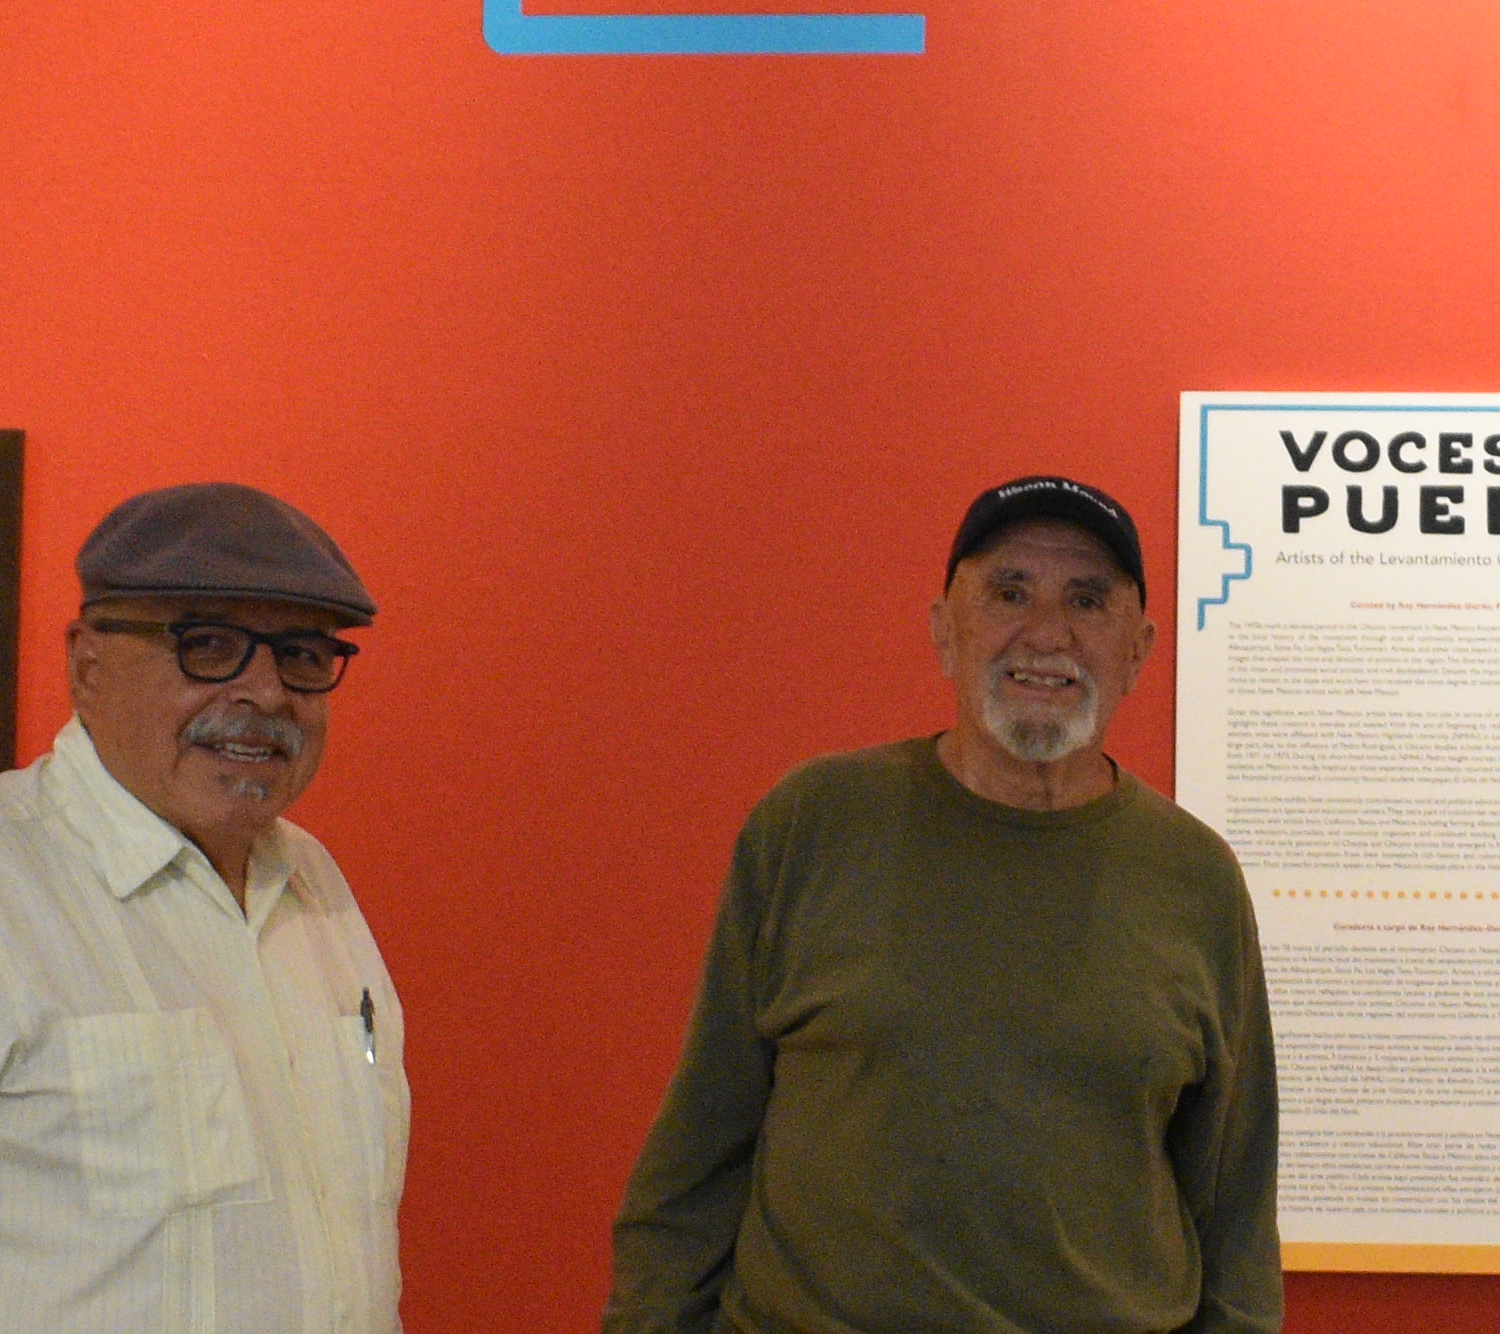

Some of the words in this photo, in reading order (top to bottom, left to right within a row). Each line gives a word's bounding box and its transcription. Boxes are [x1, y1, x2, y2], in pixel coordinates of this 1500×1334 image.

[1275, 550, 1324, 565] Artists
[1329, 550, 1344, 565] of
[1350, 550, 1375, 565] the
[1379, 551, 1492, 566] Levantamiento
